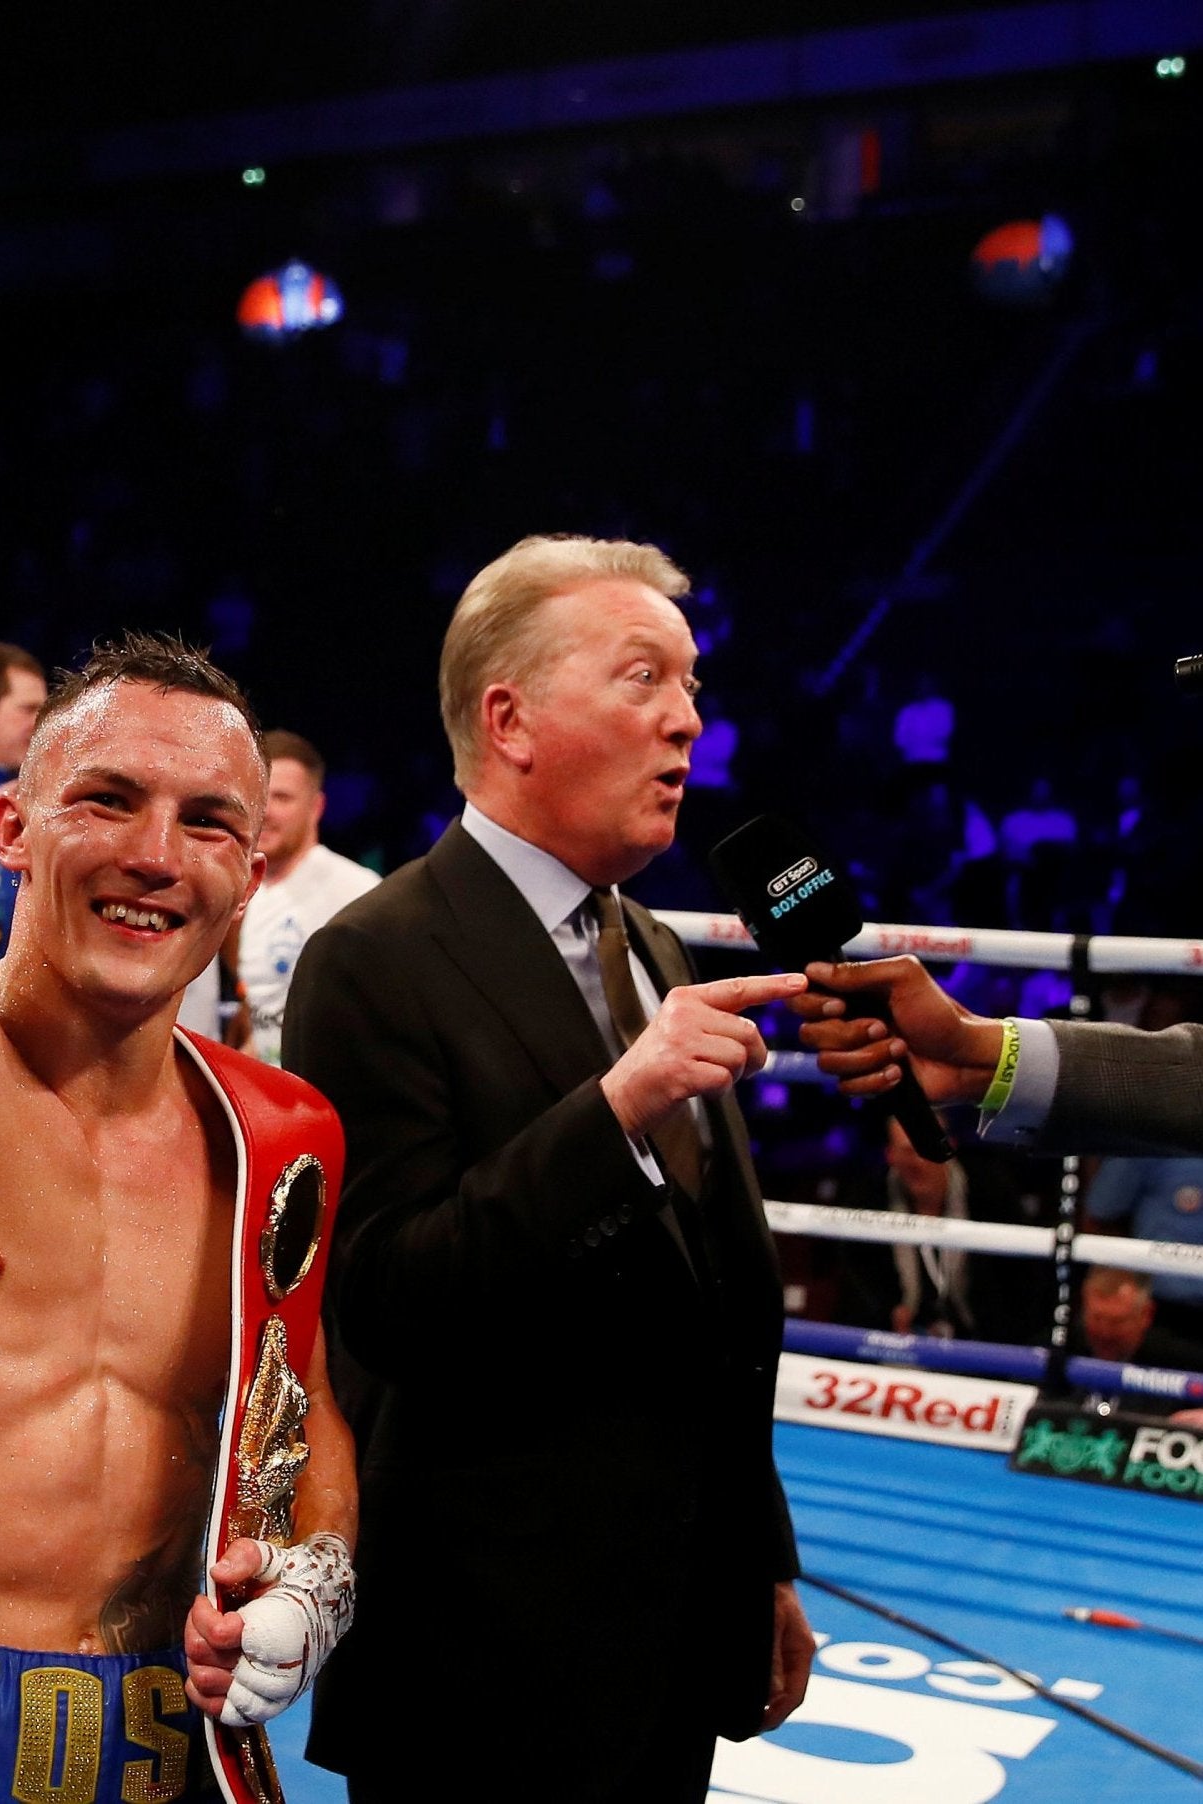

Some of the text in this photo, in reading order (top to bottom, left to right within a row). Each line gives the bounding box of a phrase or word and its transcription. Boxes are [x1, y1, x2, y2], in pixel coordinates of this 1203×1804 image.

[770, 868, 835, 919] BOX OFFICE
[773, 876, 789, 892] BT
[806, 1371, 1001, 1433] 32Red
[1129, 1427, 1203, 1475] FO
